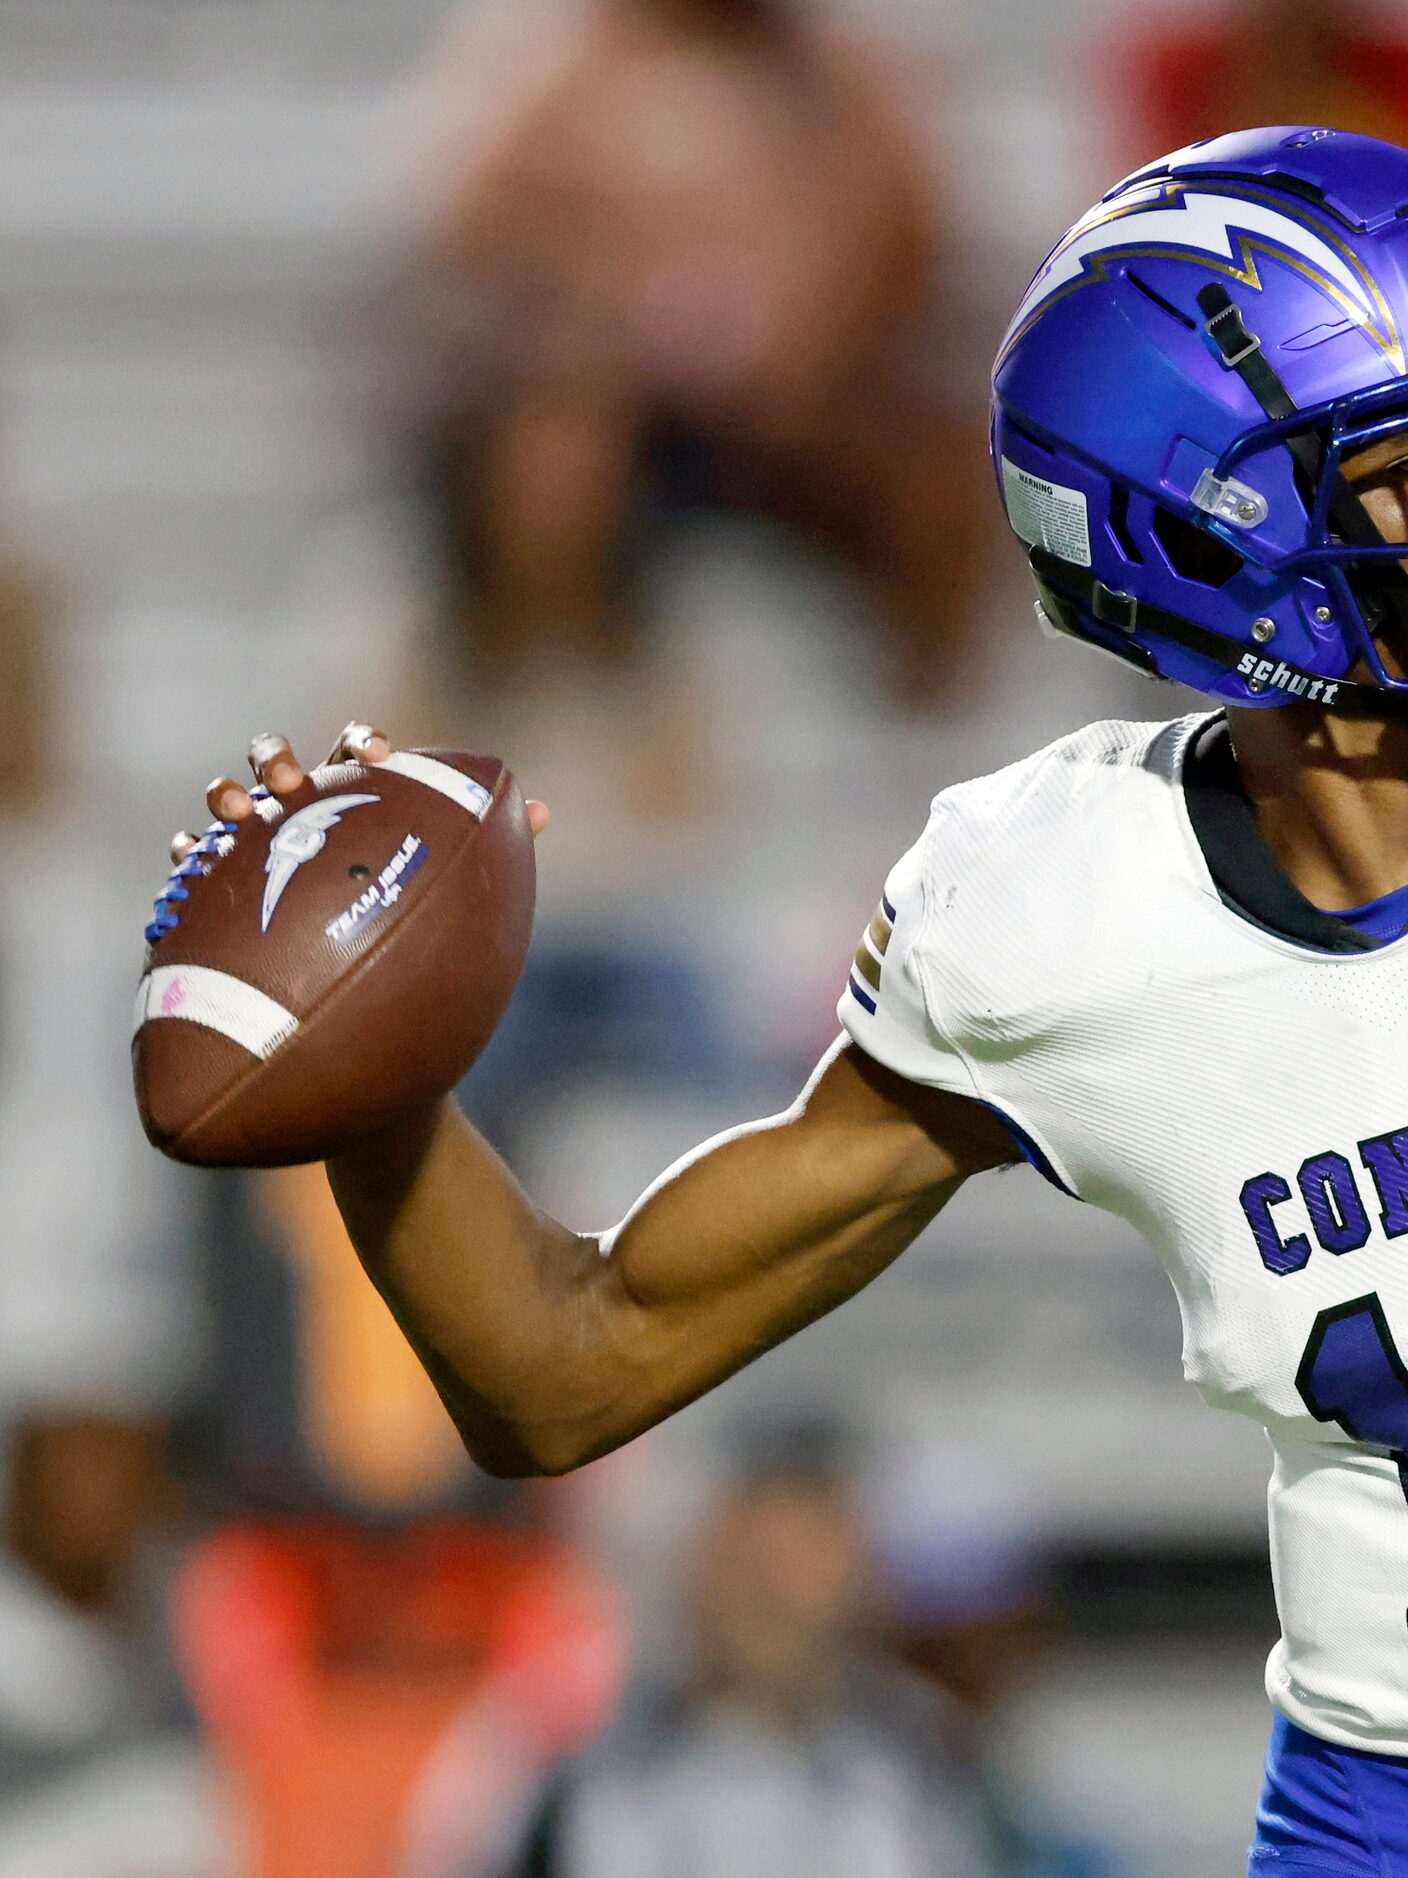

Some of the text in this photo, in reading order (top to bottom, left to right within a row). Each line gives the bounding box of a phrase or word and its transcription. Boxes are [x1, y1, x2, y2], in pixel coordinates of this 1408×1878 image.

[1018, 472, 1054, 495] WARNING
[1236, 652, 1340, 704] schutt
[325, 884, 381, 941] TEAM
